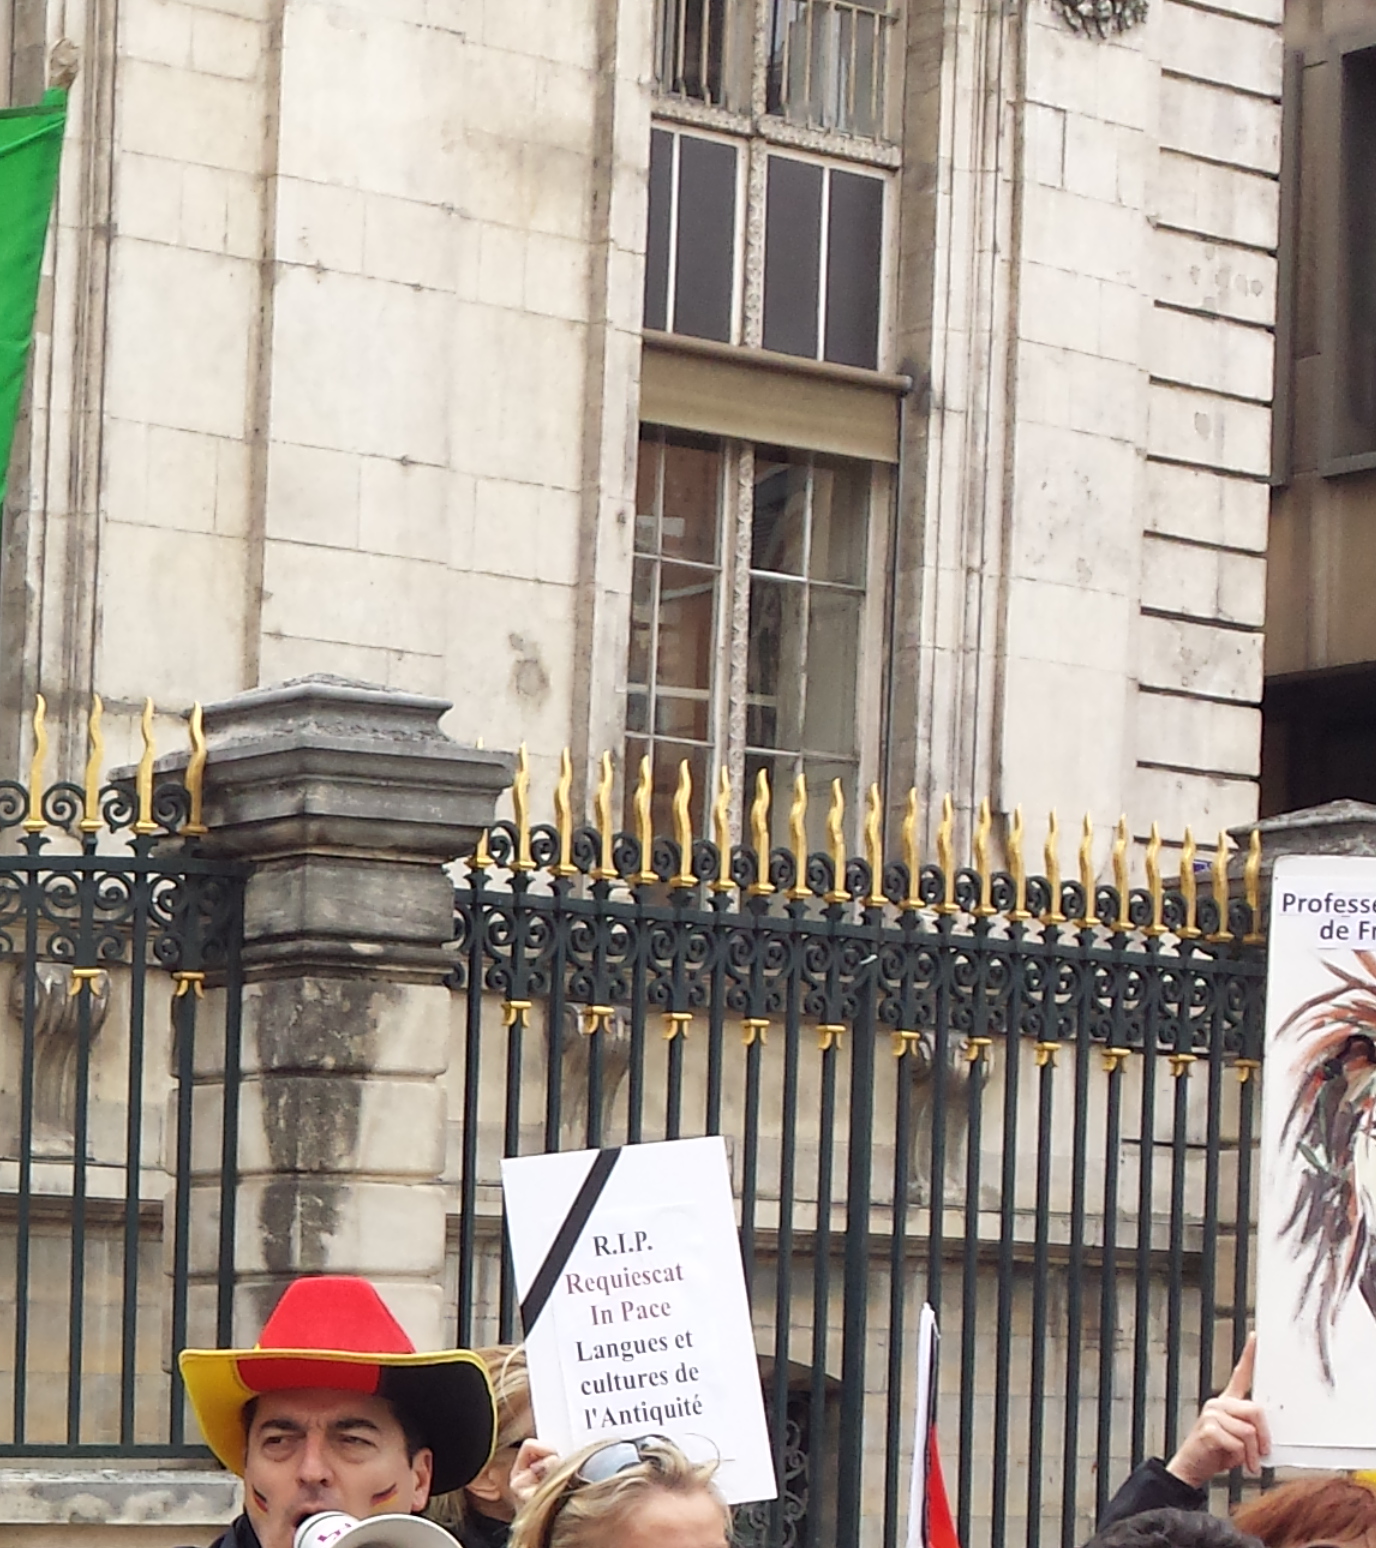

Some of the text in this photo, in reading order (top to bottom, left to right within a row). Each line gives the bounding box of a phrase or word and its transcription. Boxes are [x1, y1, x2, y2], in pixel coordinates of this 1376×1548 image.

[1282, 892, 1376, 914] Profess
[1320, 919, 1349, 940] de
[593, 1231, 653, 1257] R.I.P.
[565, 1262, 685, 1296] Requiescat
[590, 1299, 672, 1326] In Pace
[576, 1330, 694, 1363] Langues et
[581, 1362, 700, 1397] cultures de
[583, 1394, 704, 1430] l'Antiquité
